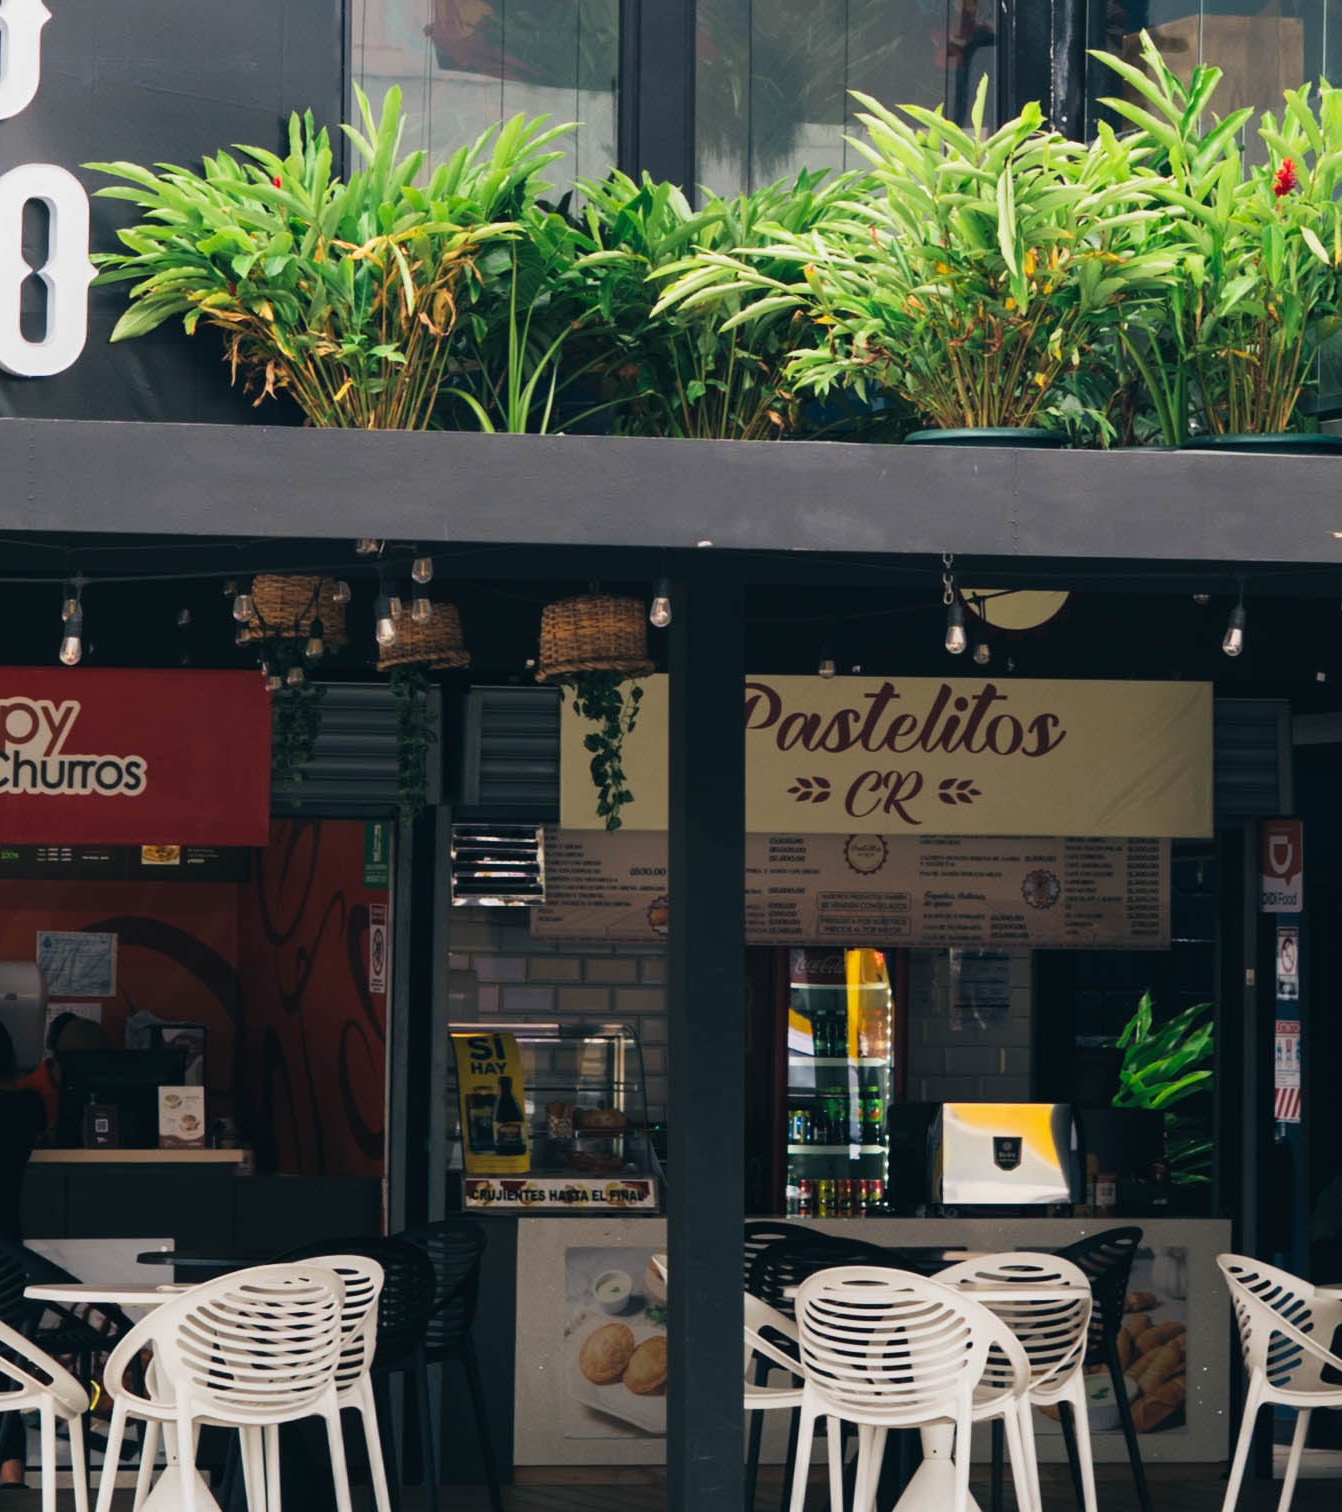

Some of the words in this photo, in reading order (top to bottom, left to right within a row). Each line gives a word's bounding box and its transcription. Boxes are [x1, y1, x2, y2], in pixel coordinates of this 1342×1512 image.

[745, 681, 1067, 758] Pastelitos
[845, 770, 924, 826] CR
[470, 1061, 507, 1075] HAY
[471, 1188, 546, 1202] CRUJIENTES
[549, 1188, 589, 1202] HASTA
[592, 1188, 607, 1202] EL
[610, 1188, 644, 1202] FINAL
